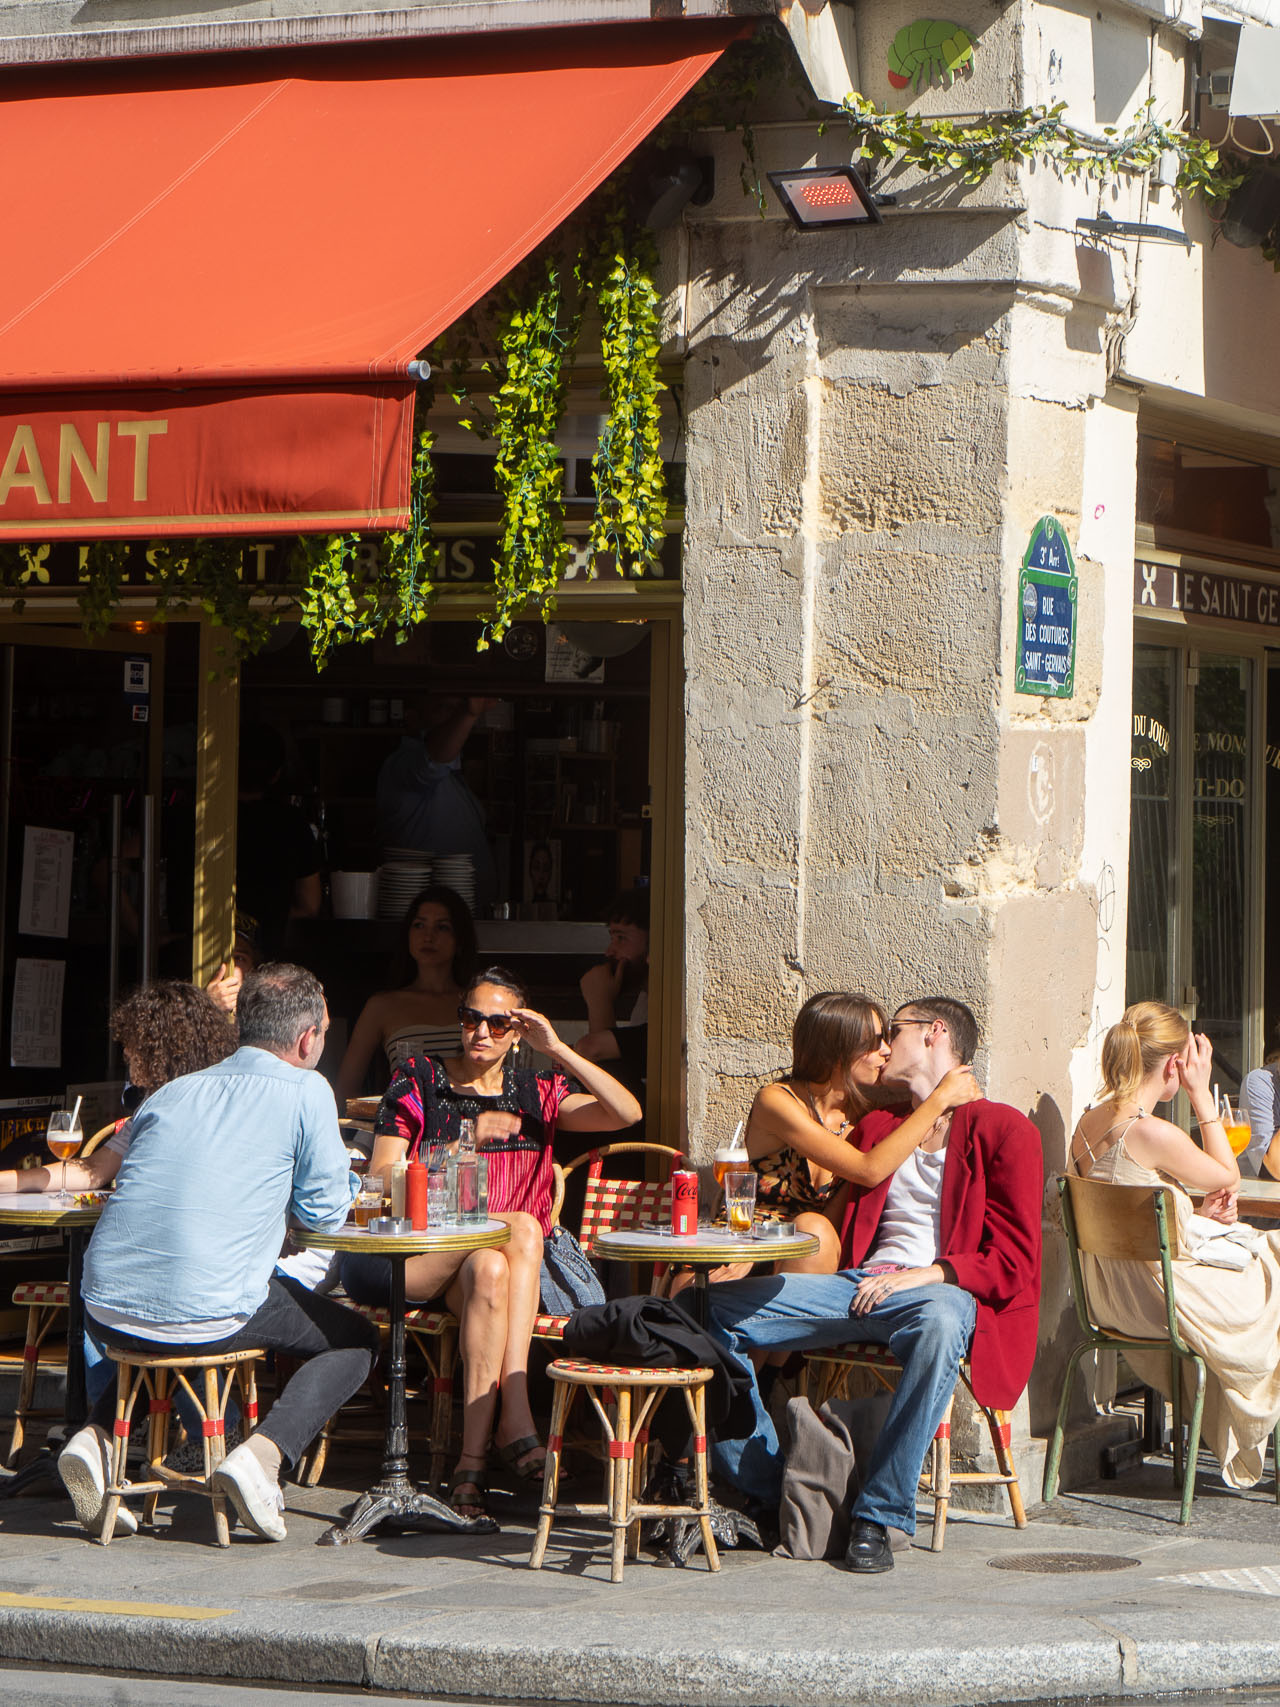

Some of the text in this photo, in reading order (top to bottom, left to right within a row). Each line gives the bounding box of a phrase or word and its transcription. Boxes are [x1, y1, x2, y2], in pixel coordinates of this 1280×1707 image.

[0, 419, 168, 505] ANT
[1042, 596, 1054, 616] RUE
[1173, 571, 1195, 610] LE
[1200, 575, 1252, 620] SAINT
[1025, 622, 1069, 646] DES COUTURES
[1025, 650, 1067, 674] SAINT-GERVAIS
[1133, 714, 1170, 754] DU JOUR
